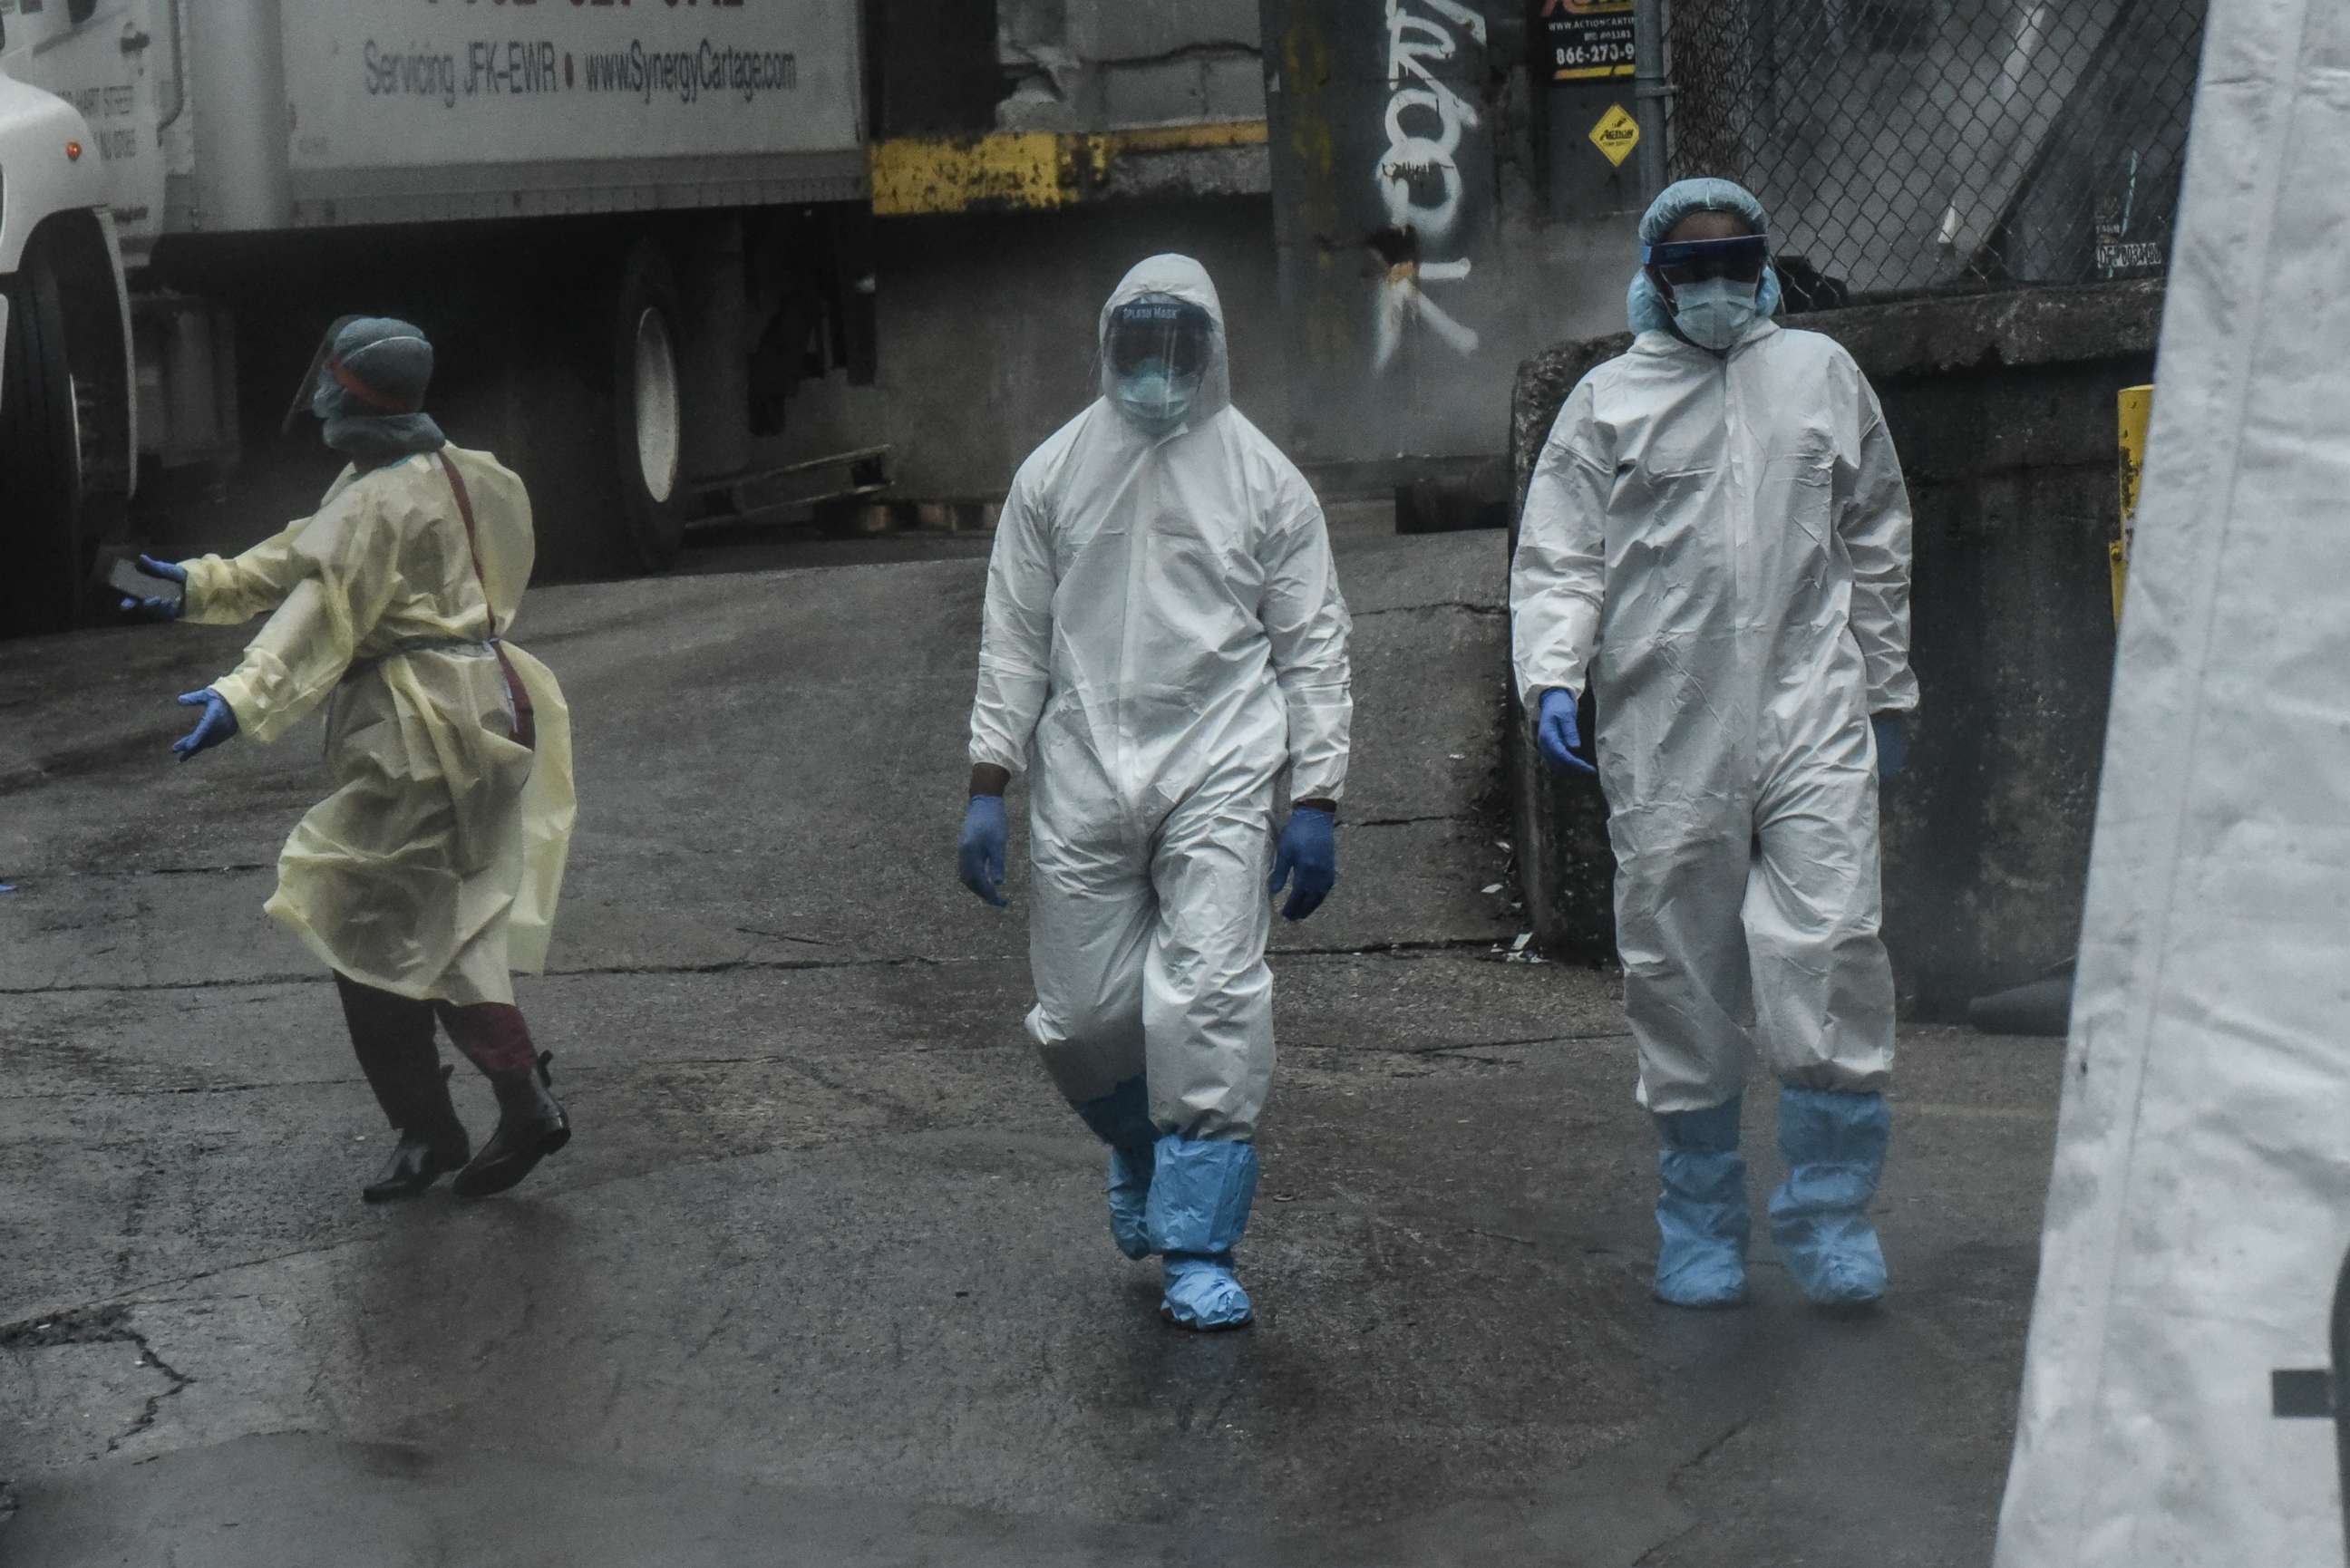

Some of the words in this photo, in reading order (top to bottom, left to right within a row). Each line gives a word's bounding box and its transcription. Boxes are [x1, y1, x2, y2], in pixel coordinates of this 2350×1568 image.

[364, 39, 454, 108] Servicing
[464, 40, 557, 94] JFK-EWR
[586, 38, 797, 104] www.SynergyCartage.com
